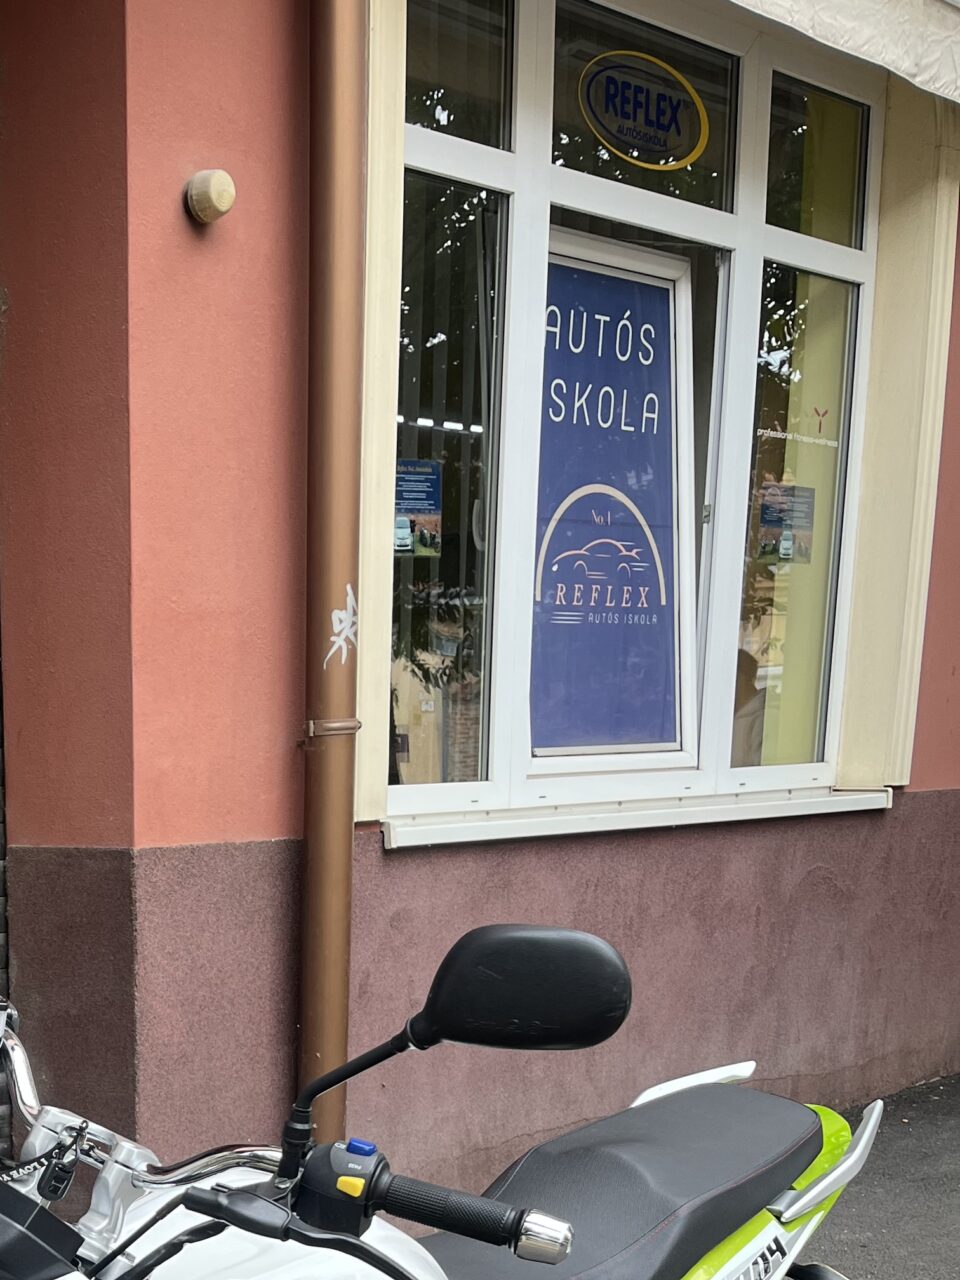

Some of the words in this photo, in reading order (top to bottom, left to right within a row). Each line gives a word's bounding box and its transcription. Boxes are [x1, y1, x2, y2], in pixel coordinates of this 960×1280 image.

[604, 75, 682, 137] REFLEX
[546, 304, 655, 366] AUTÓS
[554, 583, 649, 608] REFLEX
[578, 611, 619, 624] AUTÓS
[623, 614, 657, 625] ISKOLA
[9, 1161, 41, 1179] LOVE
